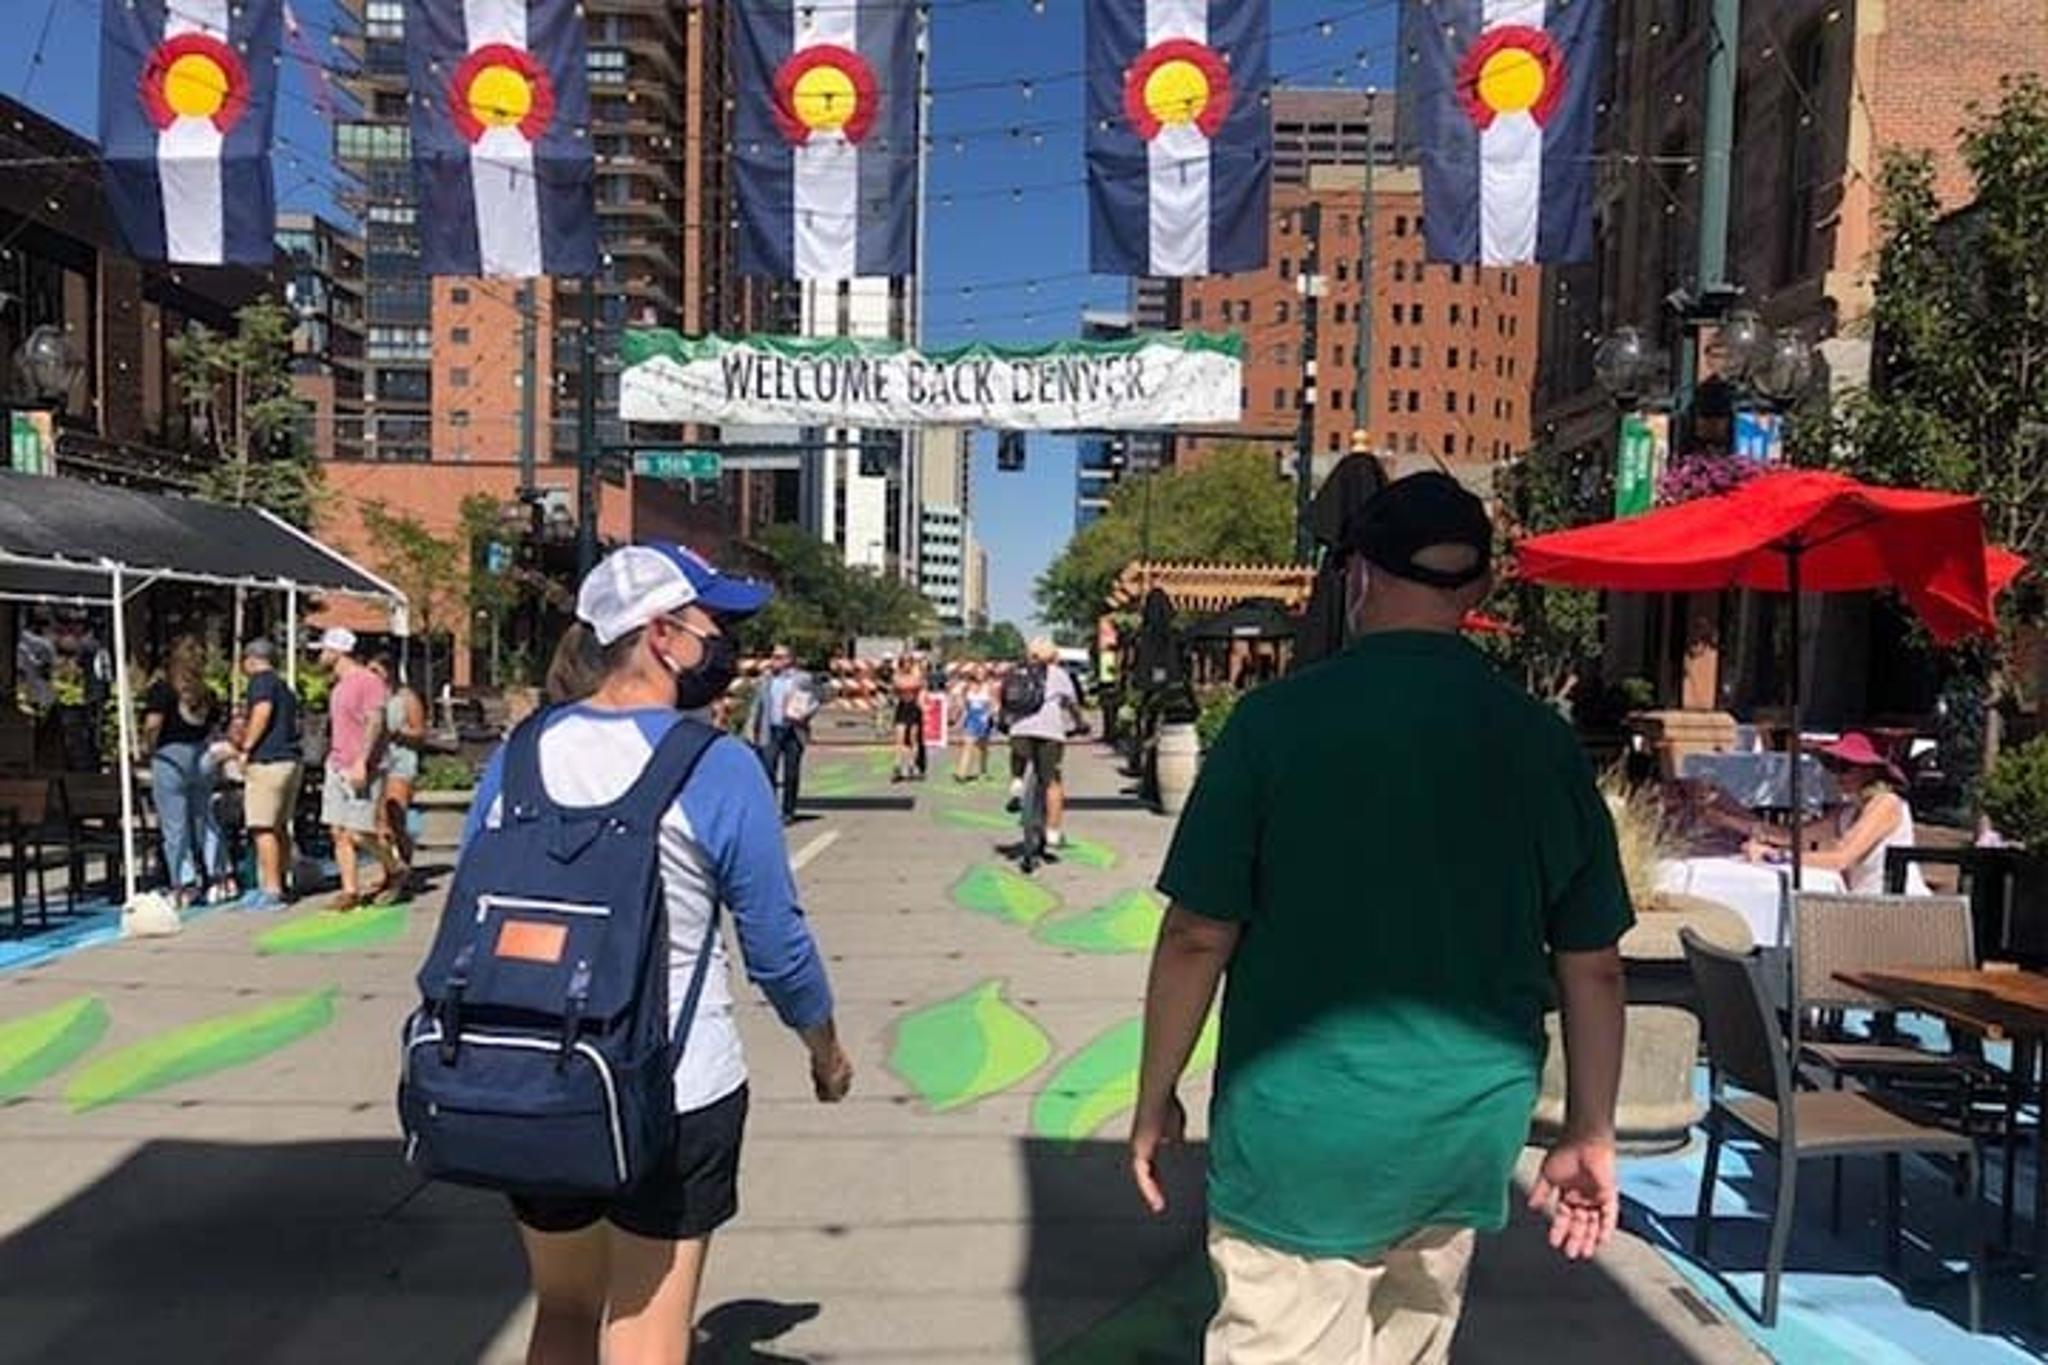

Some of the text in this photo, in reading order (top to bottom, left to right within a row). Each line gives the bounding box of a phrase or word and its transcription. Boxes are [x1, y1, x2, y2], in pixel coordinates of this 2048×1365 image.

[722, 350, 1147, 405] WELCOME BACK DENVER
